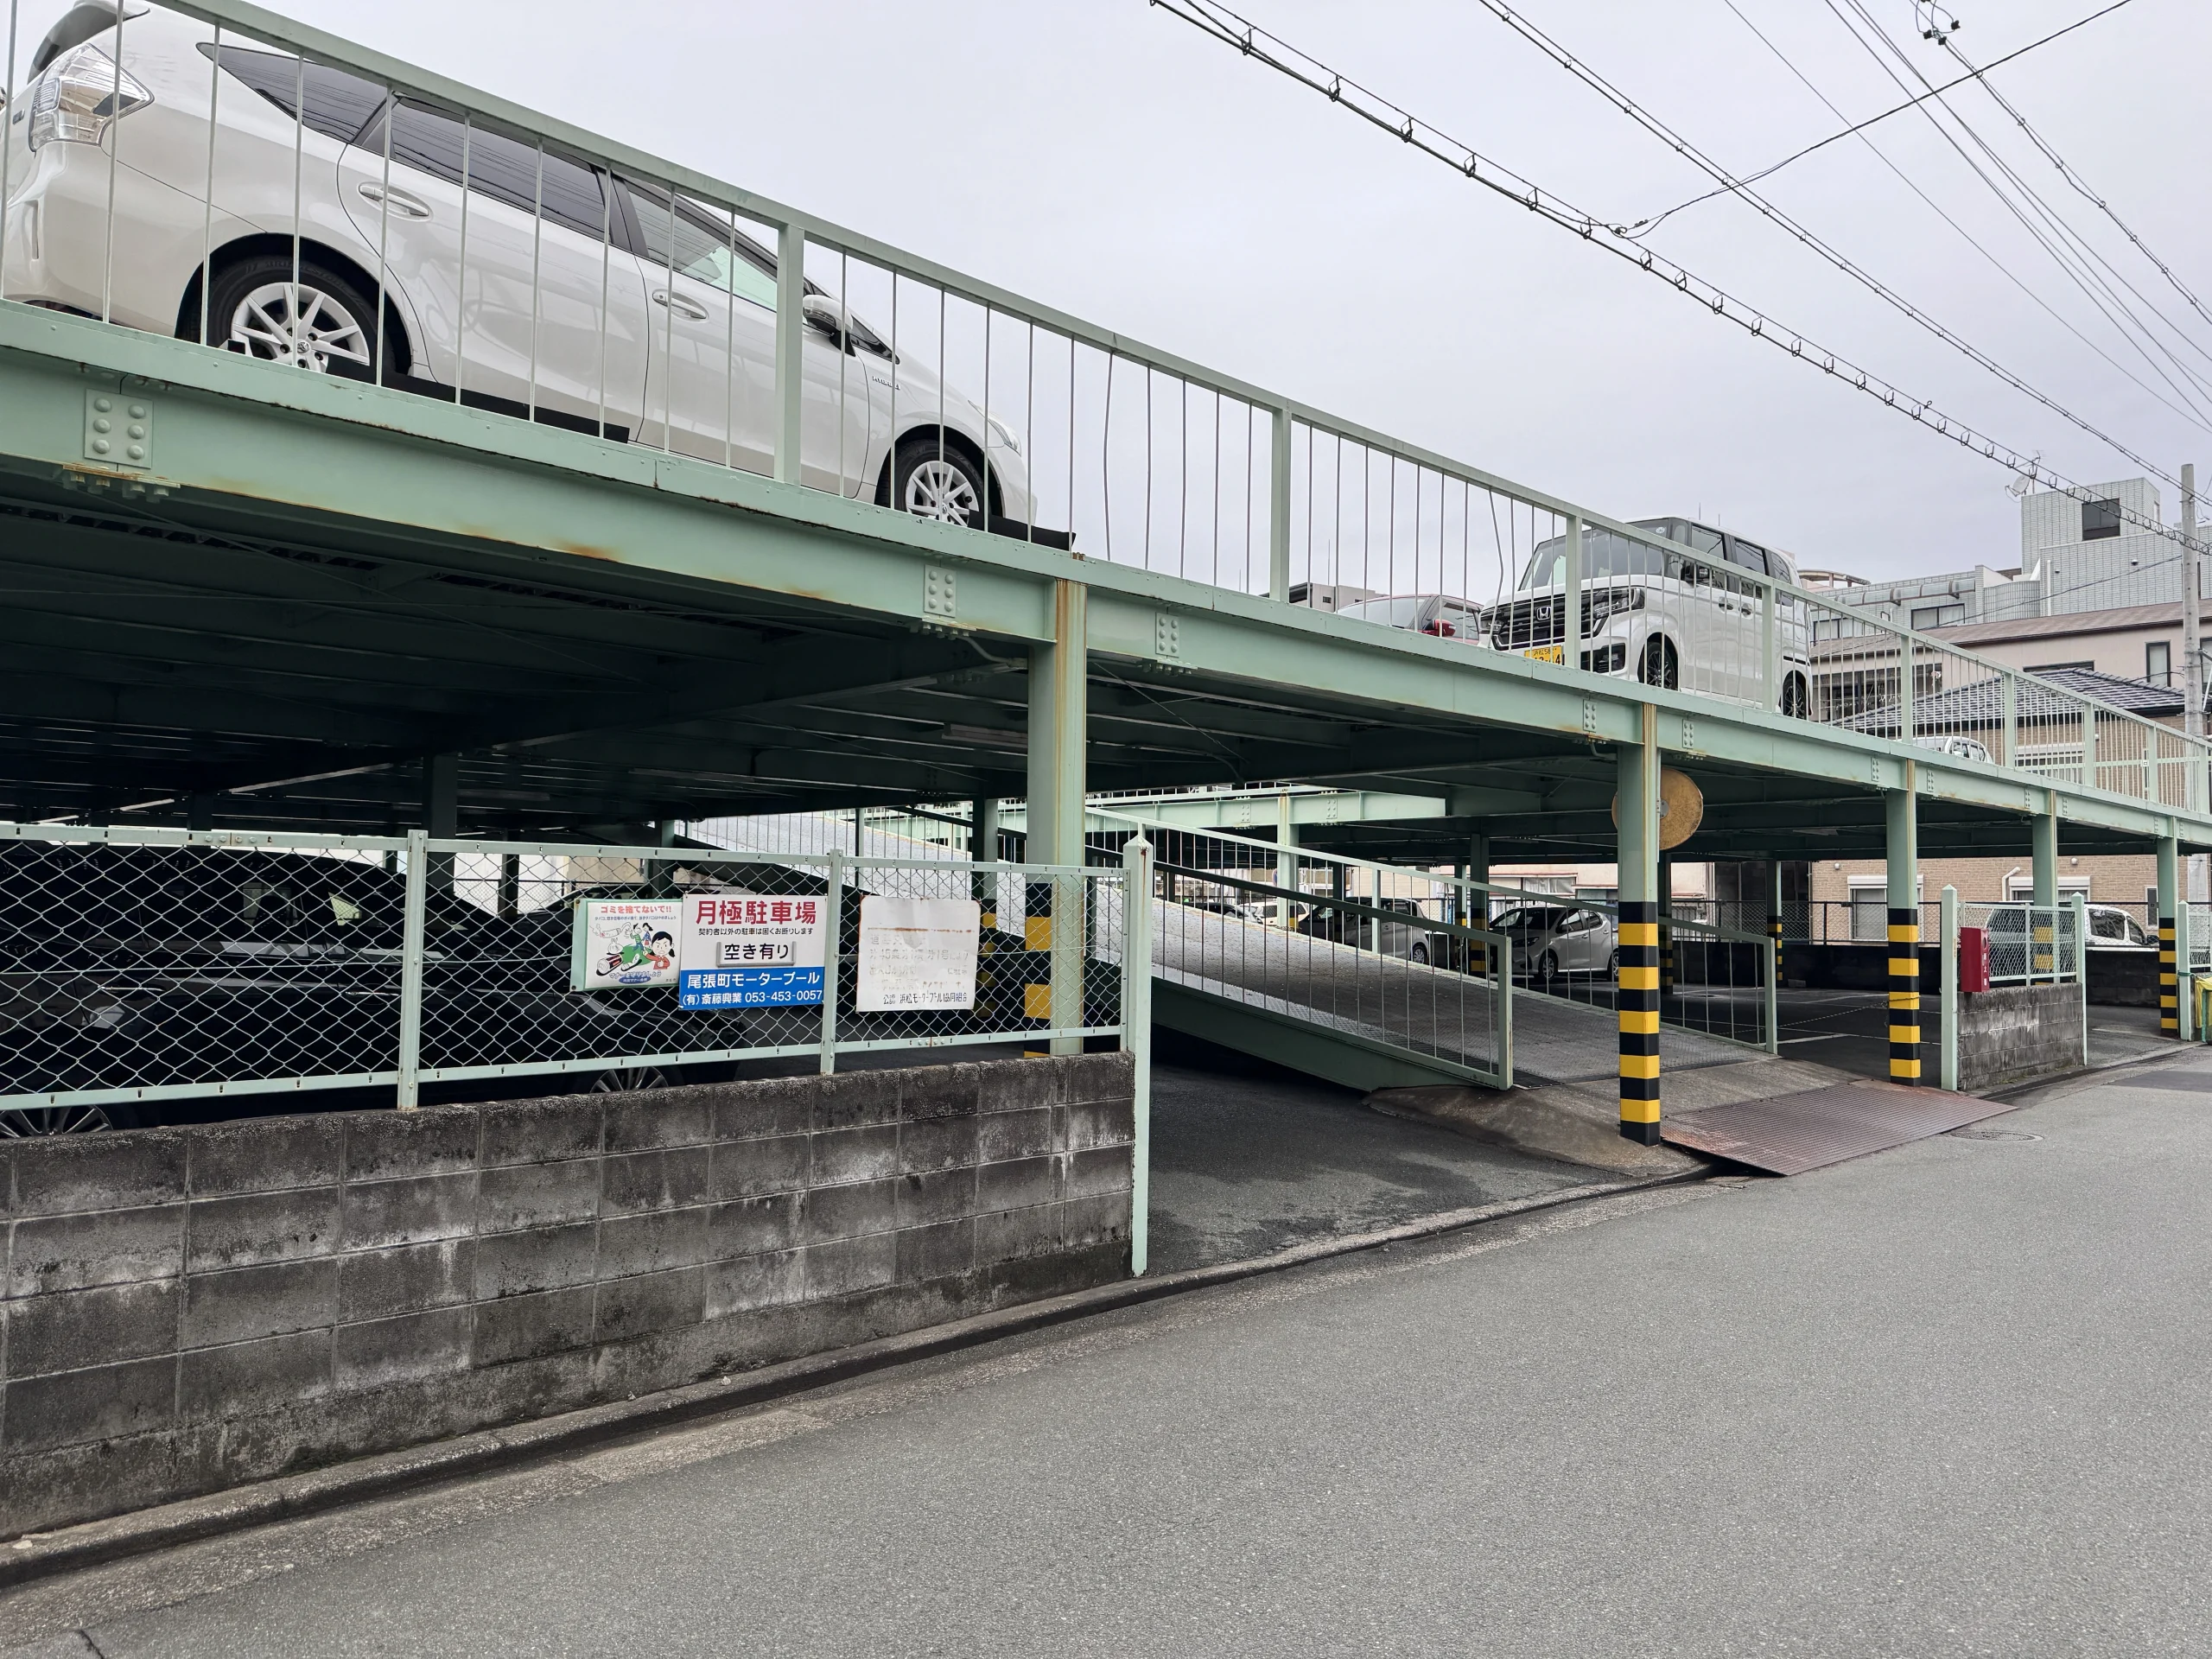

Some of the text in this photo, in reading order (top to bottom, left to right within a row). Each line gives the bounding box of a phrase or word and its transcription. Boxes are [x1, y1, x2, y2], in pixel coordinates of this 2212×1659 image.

[696, 899, 817, 925] 月極駐車場
[697, 928, 814, 937] 契約者以外の駐車は固くお断りします
[724, 944, 790, 960] 空き有り
[687, 971, 820, 989] 尾張町モータープール
[745, 989, 823, 1003] 053-453-0057
